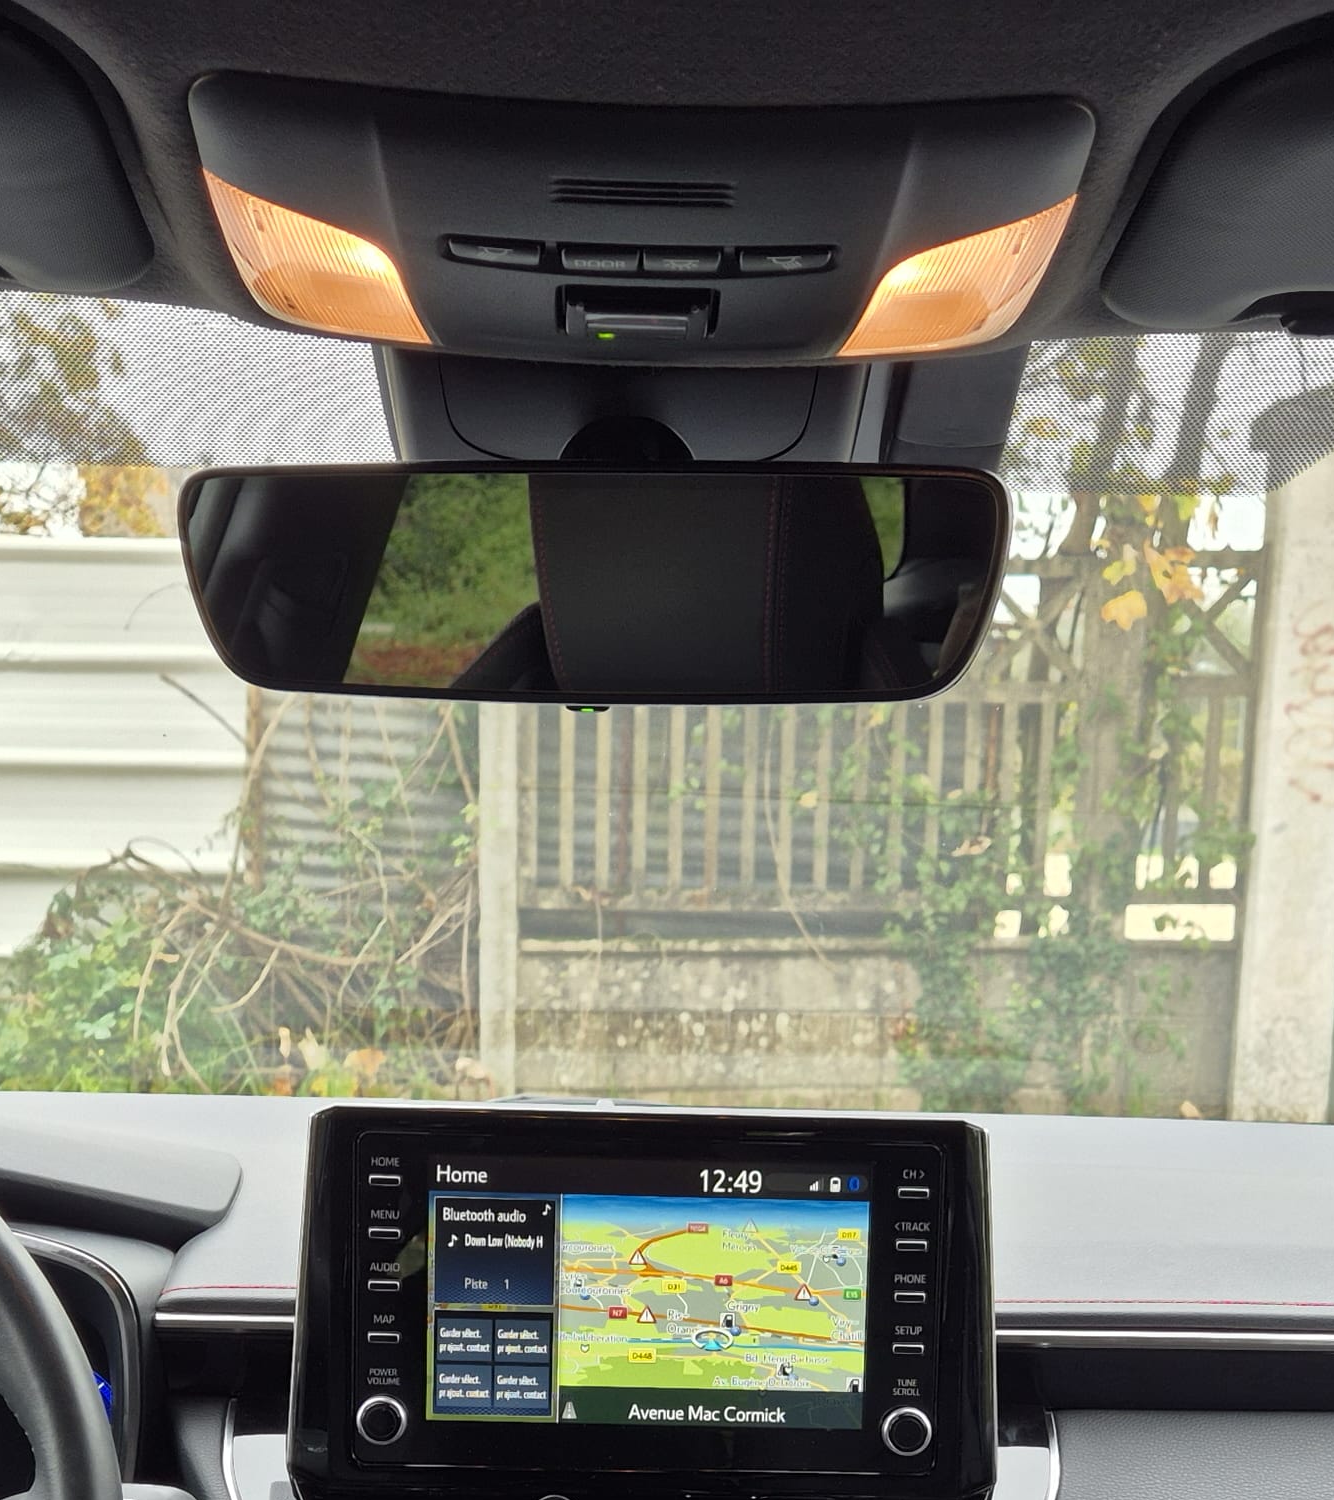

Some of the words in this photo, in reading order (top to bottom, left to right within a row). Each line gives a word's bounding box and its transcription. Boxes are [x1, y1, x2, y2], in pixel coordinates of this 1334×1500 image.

[574, 259, 625, 269] DOOR
[370, 1157, 400, 1167] HOME
[436, 1164, 488, 1183] Home
[699, 1169, 763, 1193] 12:49
[370, 1210, 400, 1220] MENU
[442, 1207, 495, 1222] Bluetooth
[497, 1209, 527, 1223] audio
[464, 1234, 486, 1247] Down
[487, 1234, 503, 1247] Low
[504, 1233, 535, 1250] (Nobody
[536, 1235, 543, 1248] H
[369, 1262, 400, 1272] AUDIO
[464, 1277, 488, 1290] Piste
[504, 1278, 509, 1289] 1
[894, 1274, 927, 1284] PHONE
[727, 1301, 760, 1313] Grigny
[373, 1314, 395, 1324] MAP
[894, 1326, 923, 1335] SETUP
[466, 1343, 491, 1353] contact
[524, 1344, 548, 1354] contact
[369, 1368, 397, 1377] POWER
[367, 1377, 401, 1386] VOLUME
[897, 1379, 918, 1387] TUNE
[465, 1389, 490, 1398] contact
[523, 1391, 547, 1400] contact
[892, 1387, 921, 1396] SCROLL
[628, 1404, 684, 1421] Avenue
[688, 1406, 721, 1421] Mac
[723, 1406, 786, 1423] Cormick
